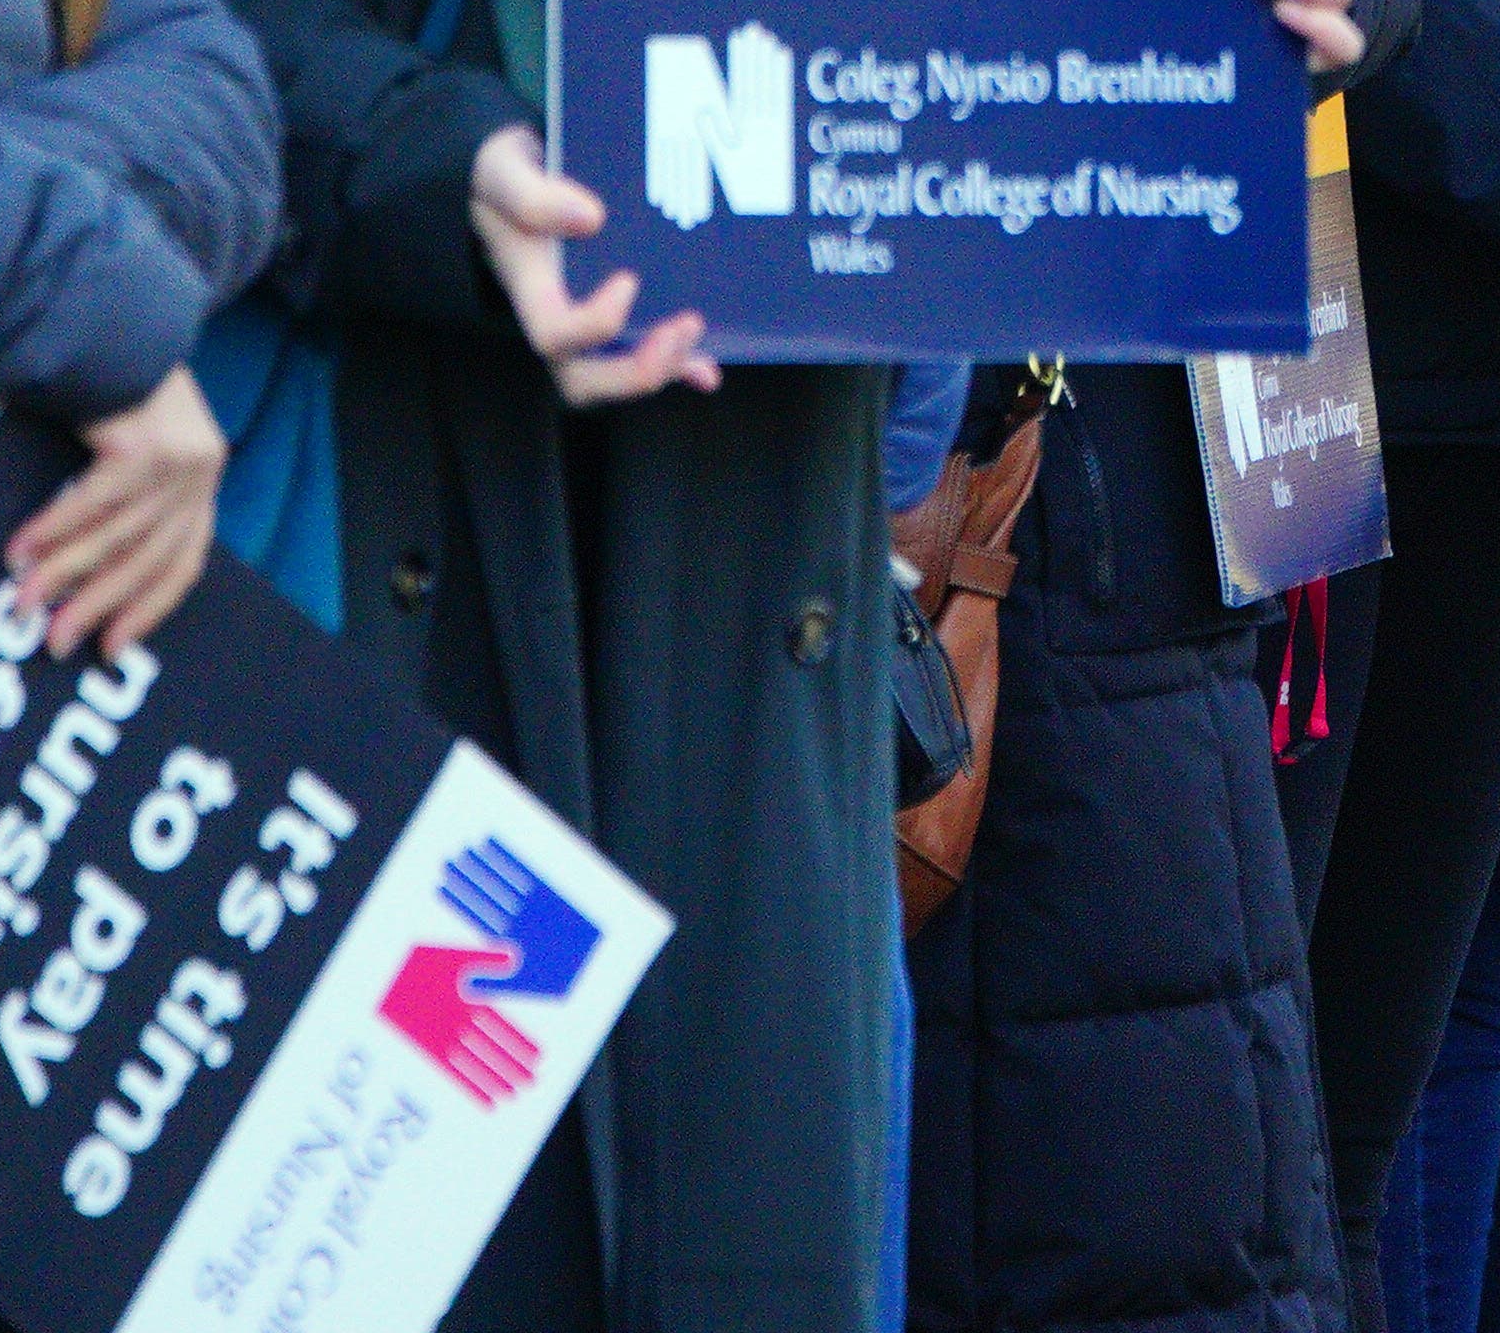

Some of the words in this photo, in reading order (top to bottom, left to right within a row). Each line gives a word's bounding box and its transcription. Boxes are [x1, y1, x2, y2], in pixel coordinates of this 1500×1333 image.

[807, 48, 920, 120] Coleg
[926, 50, 1051, 114] Nyrsio
[1057, 50, 1236, 103] Brenhinol
[808, 113, 902, 154] Cymru
[809, 160, 913, 233] Royal
[914, 162, 1052, 234] College
[1052, 163, 1093, 216] of
[1099, 166, 1242, 234] Nursing
[809, 228, 893, 273] Wales
[131, 748, 236, 870] to
[64, 959, 246, 1215] time
[195, 1108, 347, 1315] Nursing
[323, 1089, 432, 1247] Royal
